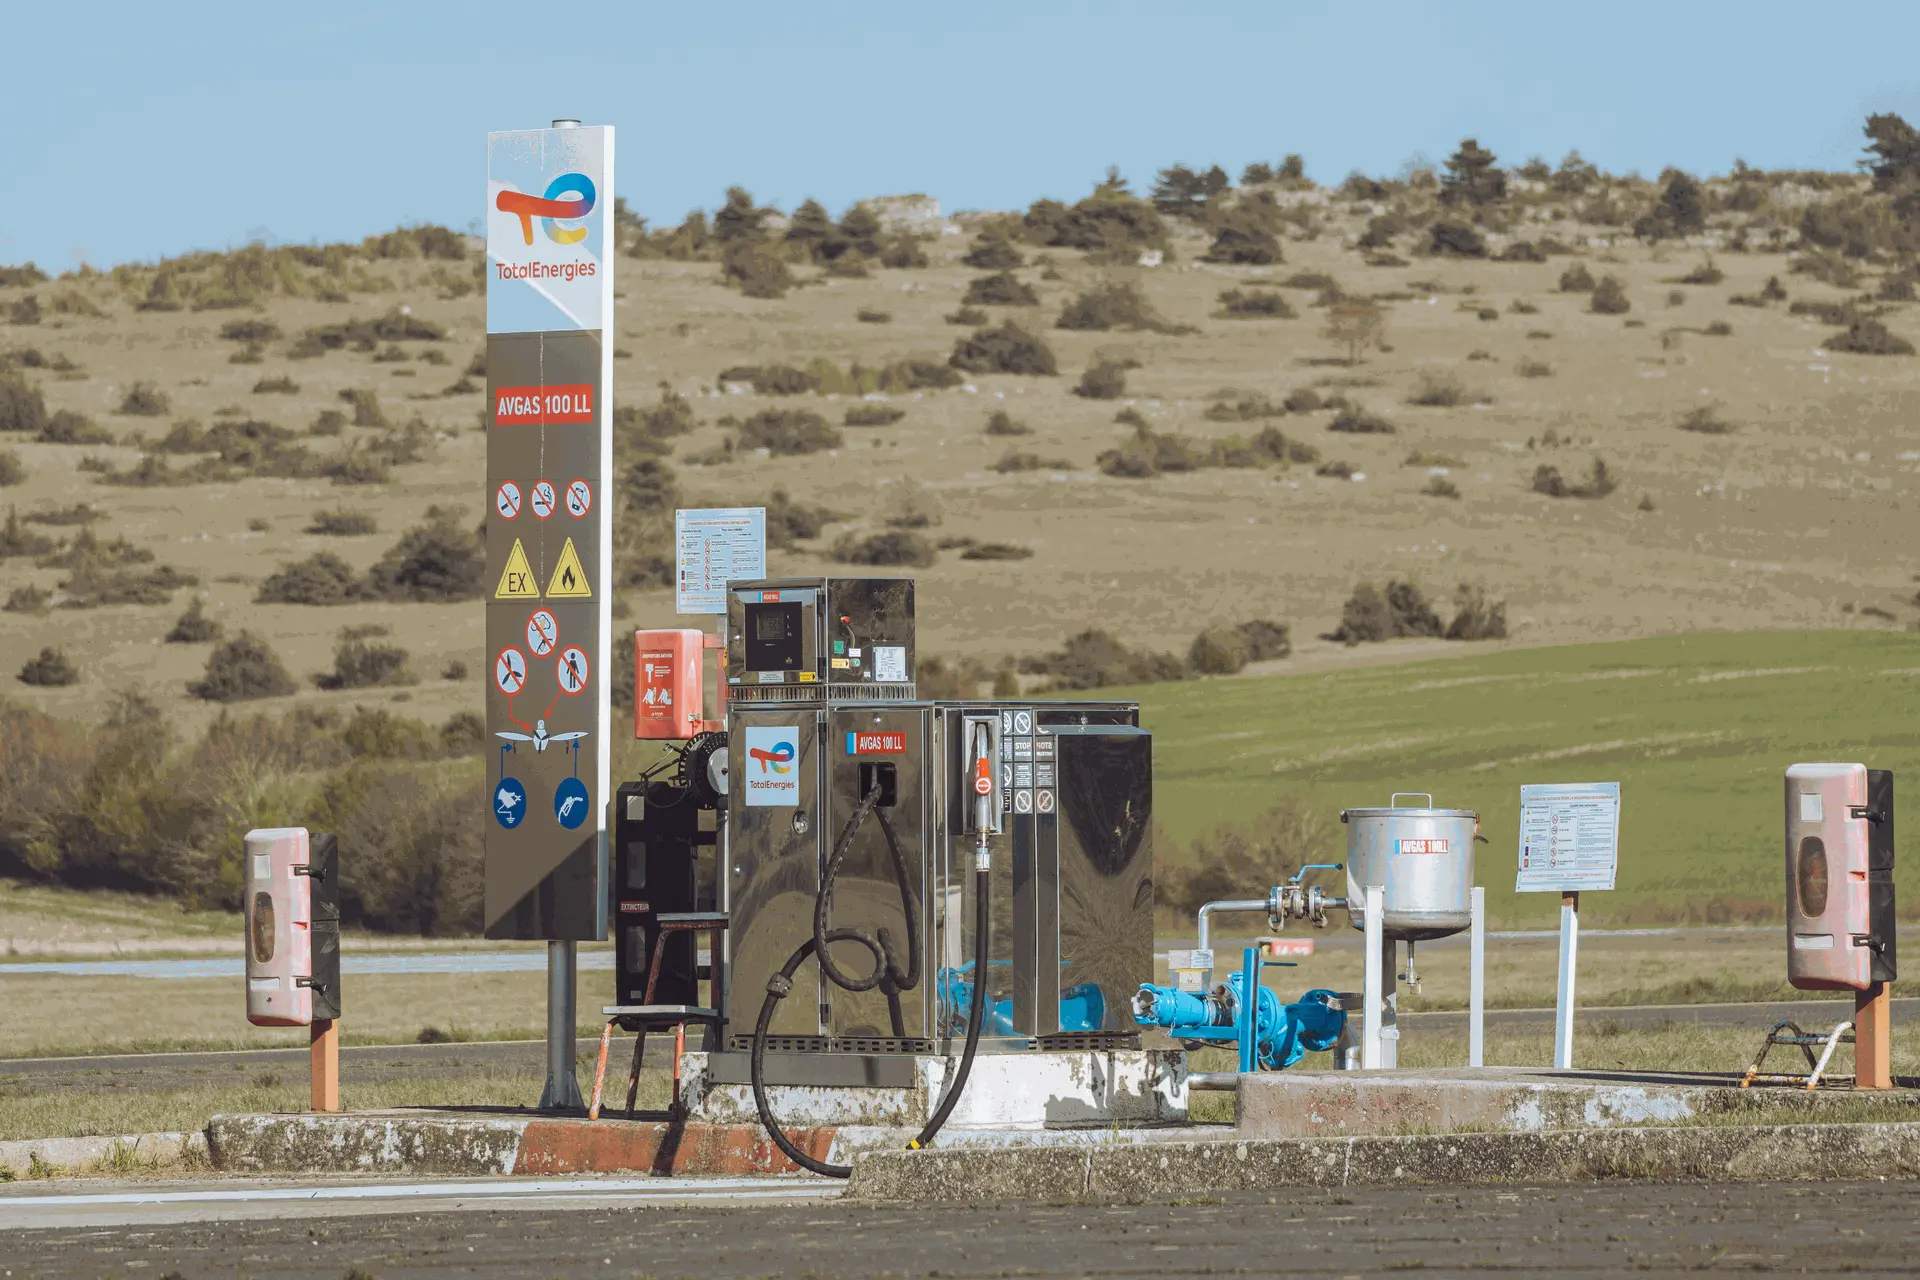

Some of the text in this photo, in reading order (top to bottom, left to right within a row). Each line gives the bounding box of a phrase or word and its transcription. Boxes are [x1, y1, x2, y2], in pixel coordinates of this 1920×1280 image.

[496, 259, 596, 281] TotalEnergies
[497, 394, 591, 416] AVGAS 100 LL
[508, 572, 527, 593] EX
[859, 736, 882, 750] AVGAS
[1015, 742, 1031, 750] STOP
[749, 780, 795, 791] TotalEnergies
[1402, 840, 1425, 853] AVGAS
[621, 903, 650, 911] EXTINCTEUR
